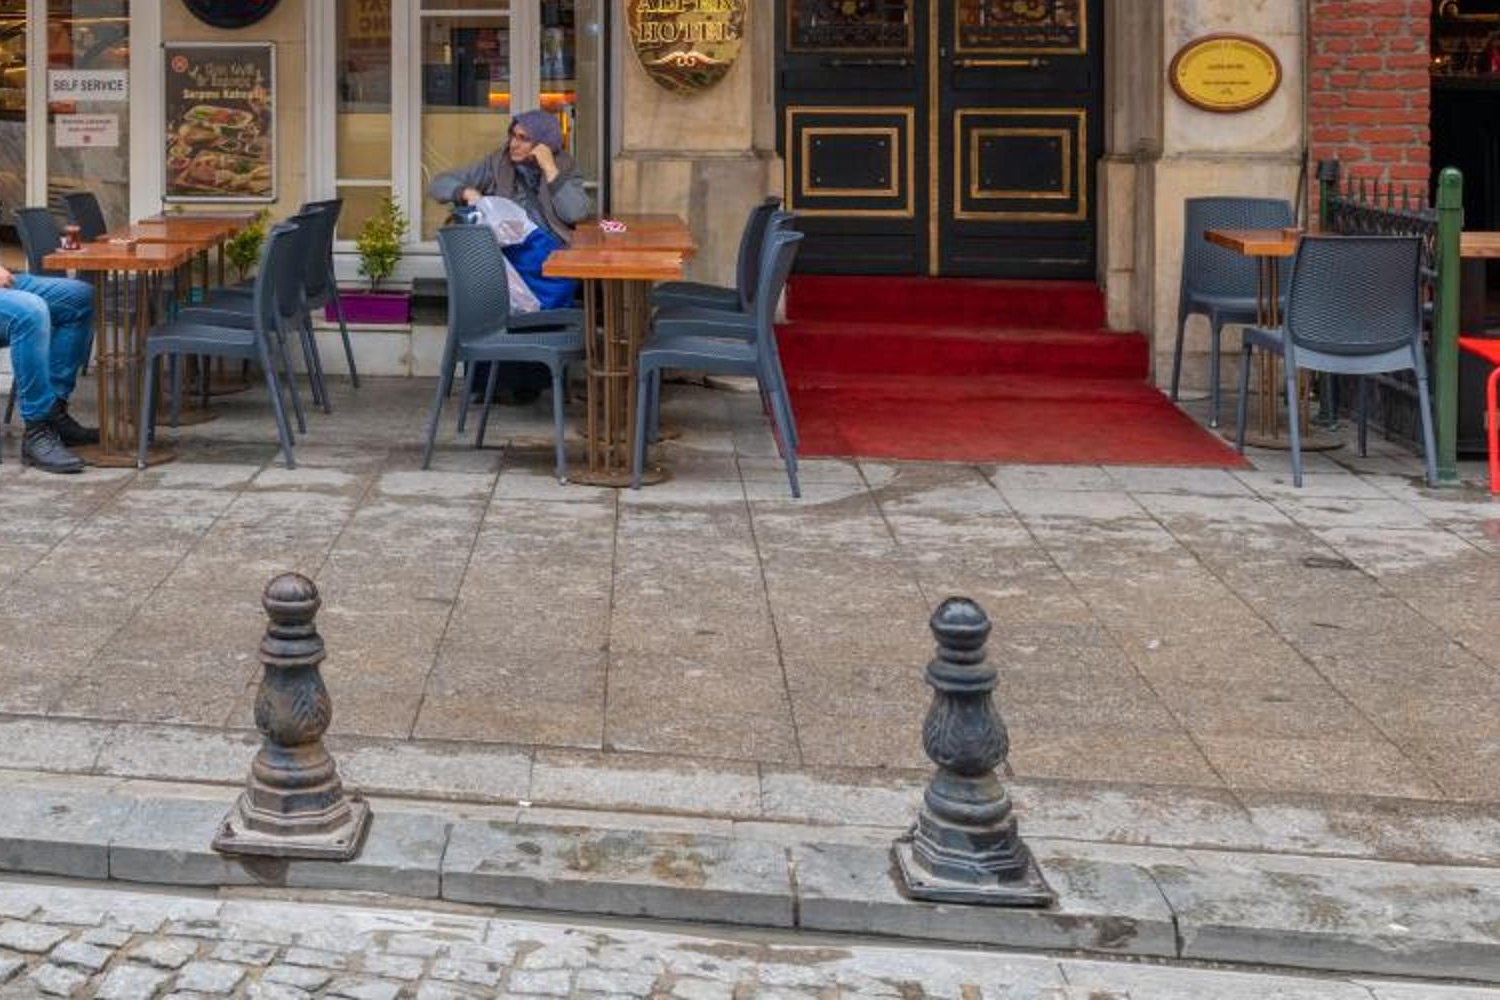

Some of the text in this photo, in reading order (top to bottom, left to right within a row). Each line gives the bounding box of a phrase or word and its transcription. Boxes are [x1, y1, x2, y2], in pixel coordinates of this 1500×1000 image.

[638, 22, 742, 43] HOTEL
[53, 78, 124, 91] SELF SERVICE
